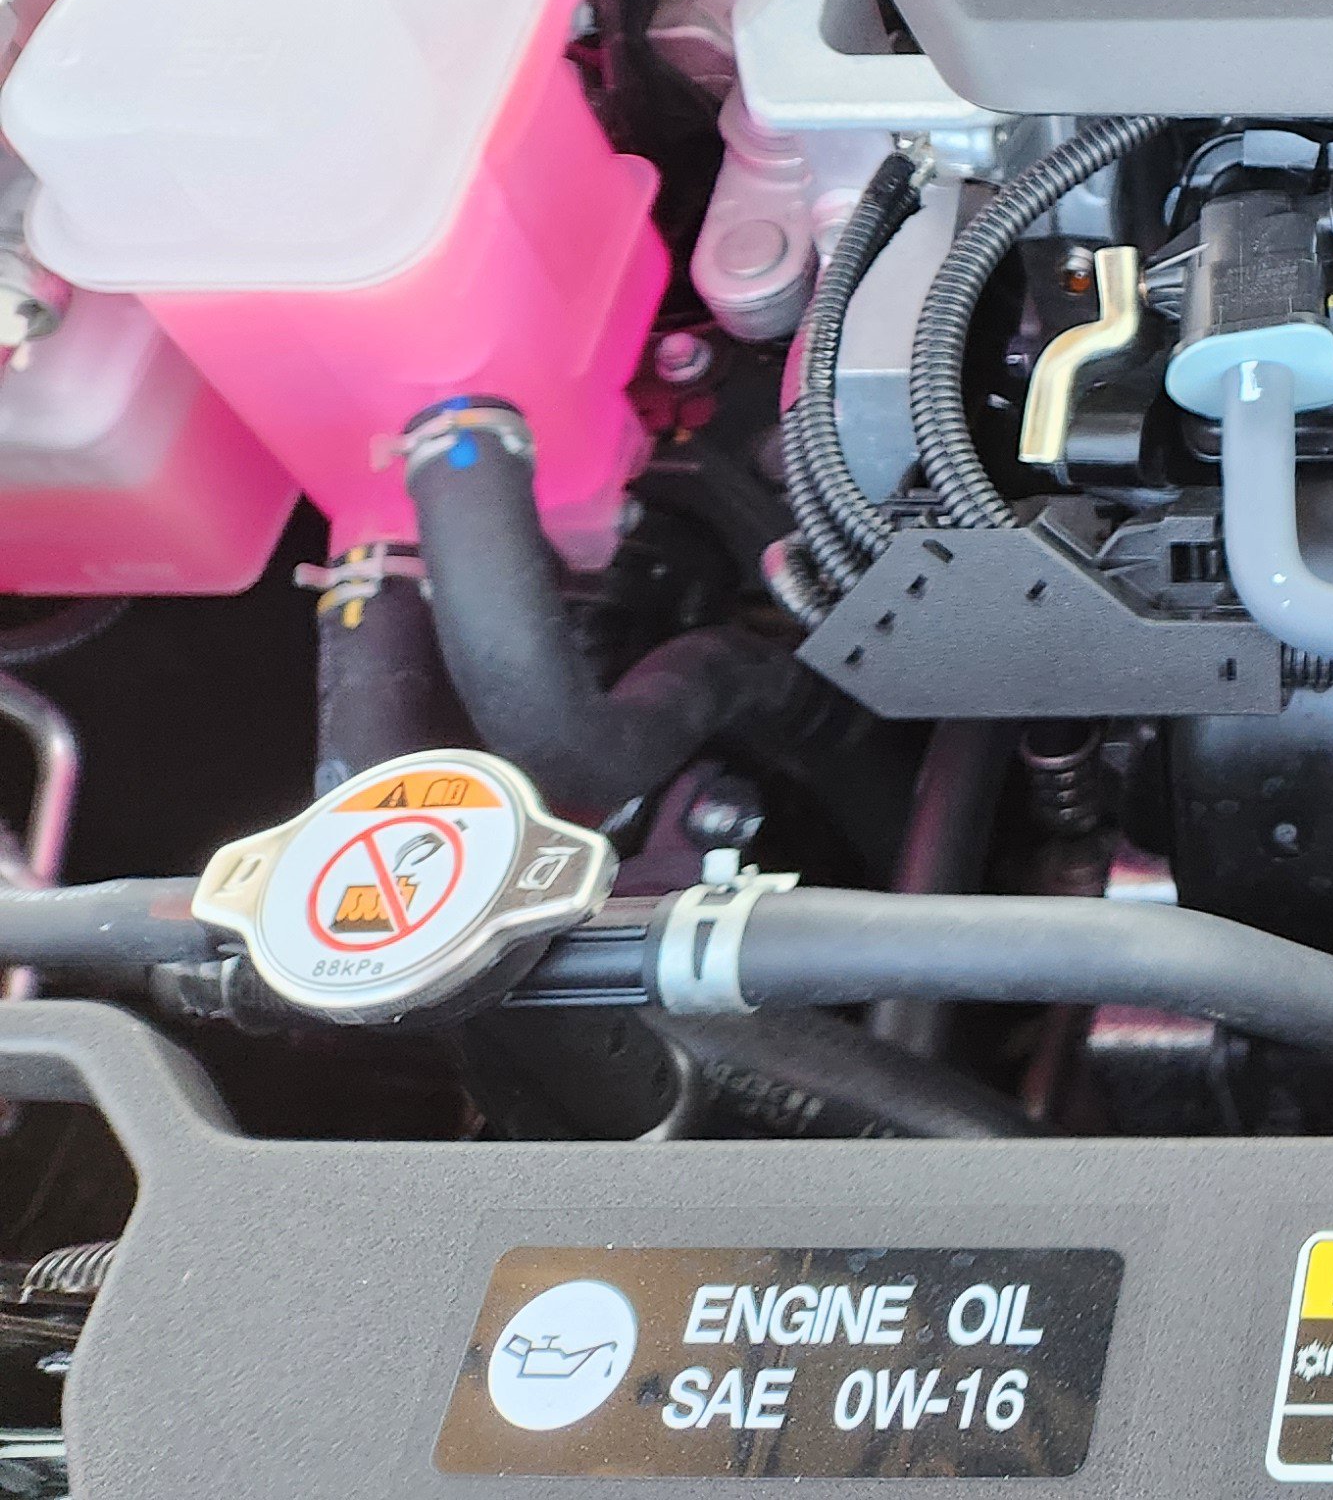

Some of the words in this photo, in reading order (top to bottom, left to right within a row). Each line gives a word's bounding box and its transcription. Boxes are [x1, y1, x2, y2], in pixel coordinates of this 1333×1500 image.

[312, 957, 384, 978] 88kPa
[682, 1283, 913, 1346] ENGINE
[948, 1283, 1044, 1345] OIL
[661, 1367, 797, 1431] SAE
[832, 1368, 1029, 1432] 0W-16
